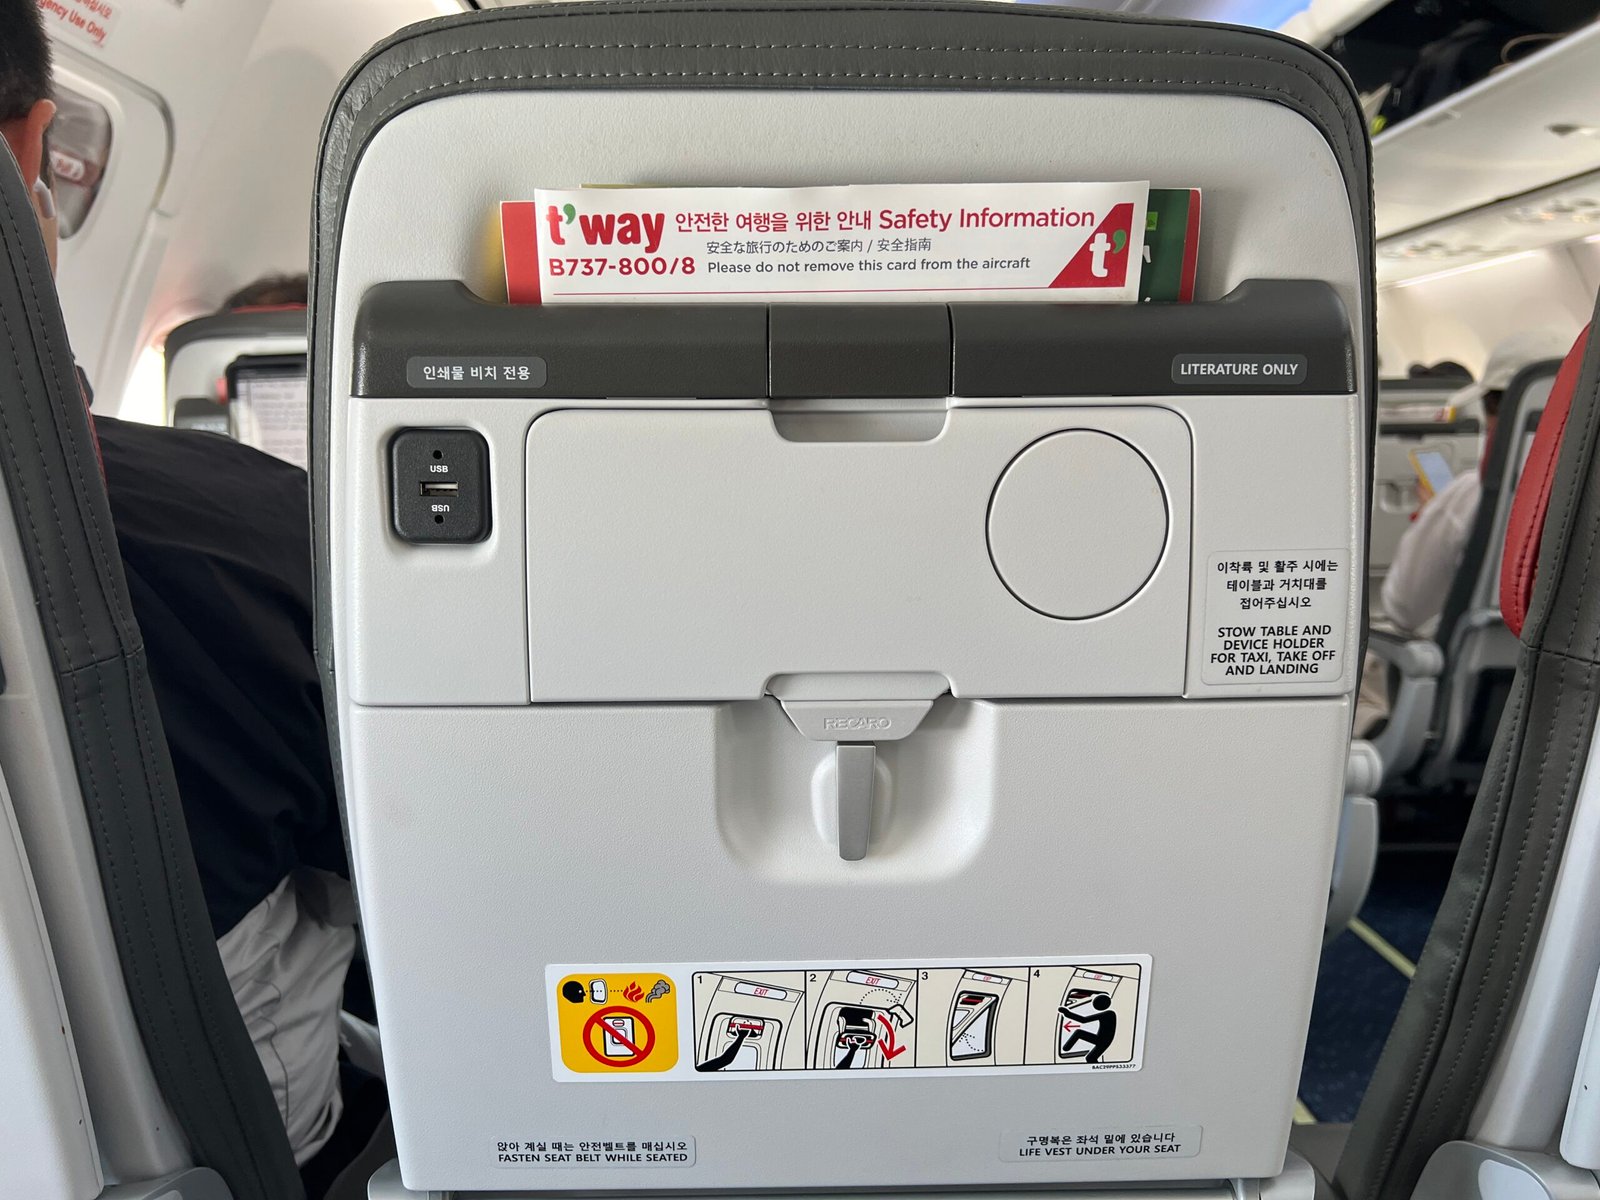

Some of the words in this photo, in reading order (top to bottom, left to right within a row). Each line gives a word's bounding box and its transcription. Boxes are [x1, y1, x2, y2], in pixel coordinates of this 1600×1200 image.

[87, 21, 107, 43] Only
[676, 212, 729, 232] 안전한
[736, 213, 788, 232] 여행을
[796, 212, 831, 231] 위한
[837, 210, 871, 230] 안내
[879, 209, 952, 232] Safety
[960, 207, 1096, 230] Information
[707, 239, 862, 254] 安全な旅行のためのご案内
[878, 237, 931, 252] 安全指南
[549, 257, 695, 276] B737-800/8
[708, 262, 751, 273] Please
[756, 262, 773, 272] do
[778, 262, 800, 272] not
[805, 263, 854, 271] remove
[859, 260, 882, 270] this
[887, 259, 916, 270] card
[921, 259, 952, 270] from
[957, 258, 978, 269] the
[982, 257, 1030, 269] aircraft
[424, 366, 464, 380] 인쇄물
[471, 366, 496, 380] 비치
[504, 366, 530, 380] 전용
[1181, 364, 1258, 375] LITERATURE
[1263, 364, 1298, 375] ONLY
[1218, 562, 1253, 574] 이착륙
[1259, 561, 1268, 573] 및
[1274, 561, 1298, 573] 활주
[1303, 560, 1338, 572] 시에는
[1227, 579, 1275, 592] 테이블과
[1280, 578, 1327, 590] 거치대를
[1240, 597, 1311, 609] 접어주십시오
[1218, 627, 1256, 637] STOW
[1260, 626, 1298, 636] TABLE
[1302, 625, 1331, 635] AND
[1224, 639, 1268, 650] DEVICE
[1273, 638, 1324, 649] HOLDER
[1211, 653, 1236, 663] FOR
[1240, 652, 1271, 663] TAXI,
[1277, 651, 1307, 661] TAKE
[1312, 650, 1336, 660] OFF
[1225, 665, 1254, 675] AND
[1260, 662, 1318, 674] LANDING
[824, 717, 891, 730] RECARO
[697, 975, 703, 984] 1
[810, 974, 816, 982] 2
[922, 971, 928, 980] 3
[1034, 969, 1040, 978] 4
[866, 976, 880, 985] EXIT
[753, 987, 769, 996] EXIT
[1027, 1136, 1072, 1146] 구명복은
[1076, 1135, 1098, 1144] 좌석
[1105, 1134, 1125, 1144] 밑에
[1131, 1133, 1175, 1143] 있습니다
[497, 1142, 519, 1151] 앉아
[525, 1142, 546, 1151] 계실
[552, 1142, 574, 1151] 때는
[579, 1142, 636, 1151] 안전벨트를
[642, 1142, 687, 1151] 매십시오
[1020, 1148, 1040, 1156] LIFE
[1076, 1147, 1115, 1155] UNDER
[1120, 1146, 1150, 1154] YOUR
[1154, 1145, 1181, 1153] SEAT
[499, 1154, 540, 1162] FASTEN
[545, 1154, 571, 1162] SEAT
